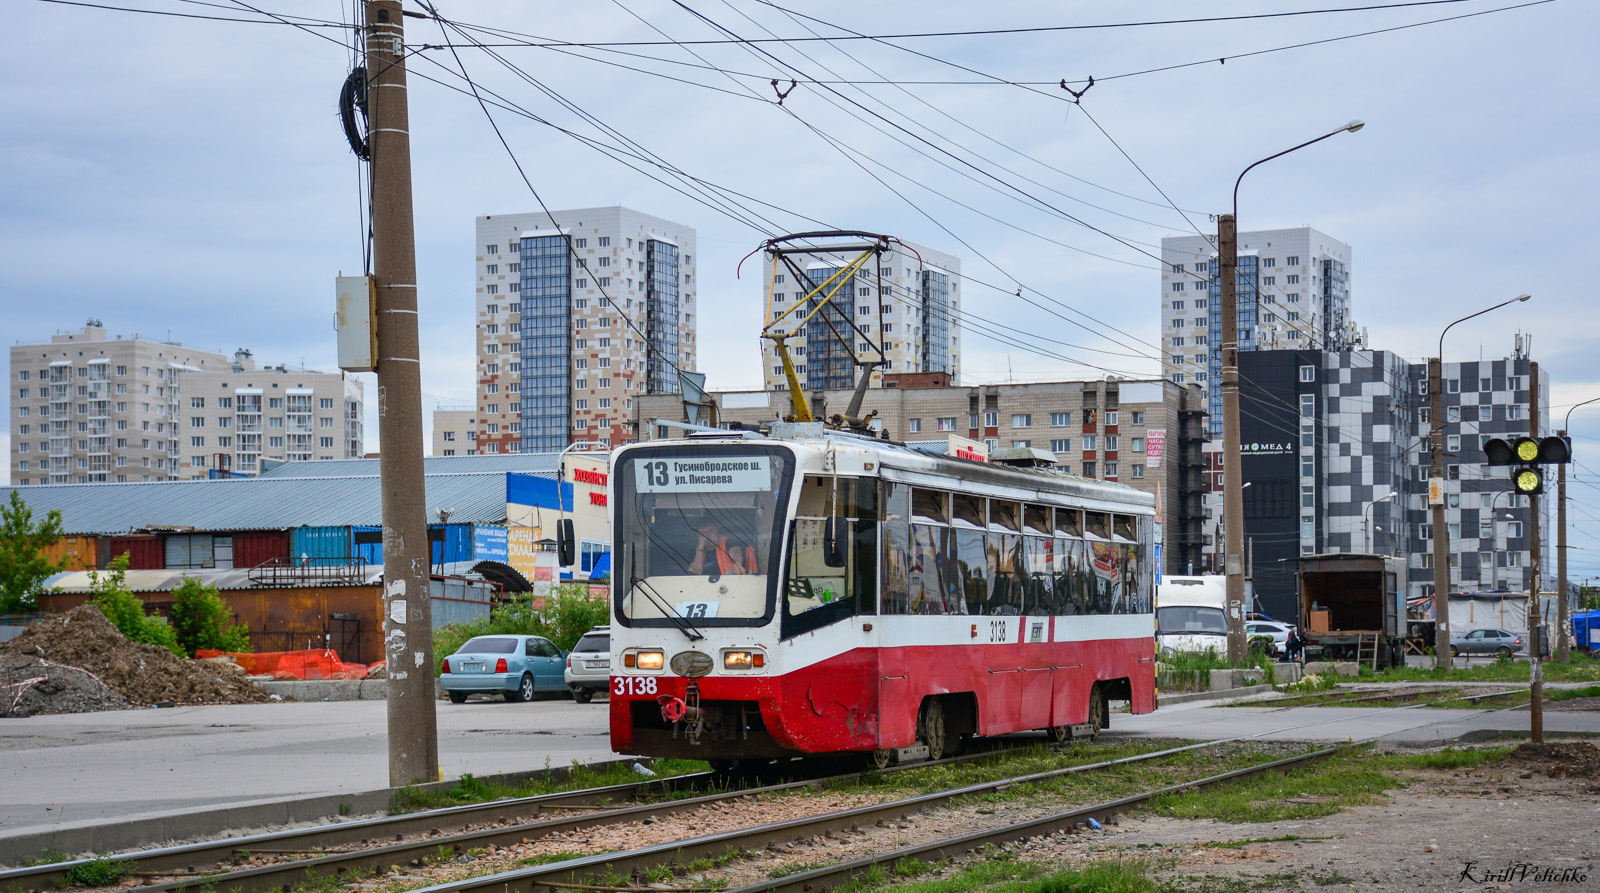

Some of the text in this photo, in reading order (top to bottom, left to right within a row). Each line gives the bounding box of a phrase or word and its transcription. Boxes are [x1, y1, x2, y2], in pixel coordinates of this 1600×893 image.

[1286, 442, 1291, 450] 4
[643, 461, 669, 486] 13
[674, 462, 761, 473] Гусинобродское ш.
[573, 467, 608, 486] ХОЗЯЙСТ
[675, 474, 733, 485] ул. Писарева
[509, 529, 538, 544] АРЕНДА
[686, 603, 708, 618] 13
[990, 620, 1006, 642] 3138
[614, 676, 658, 695] 3138
